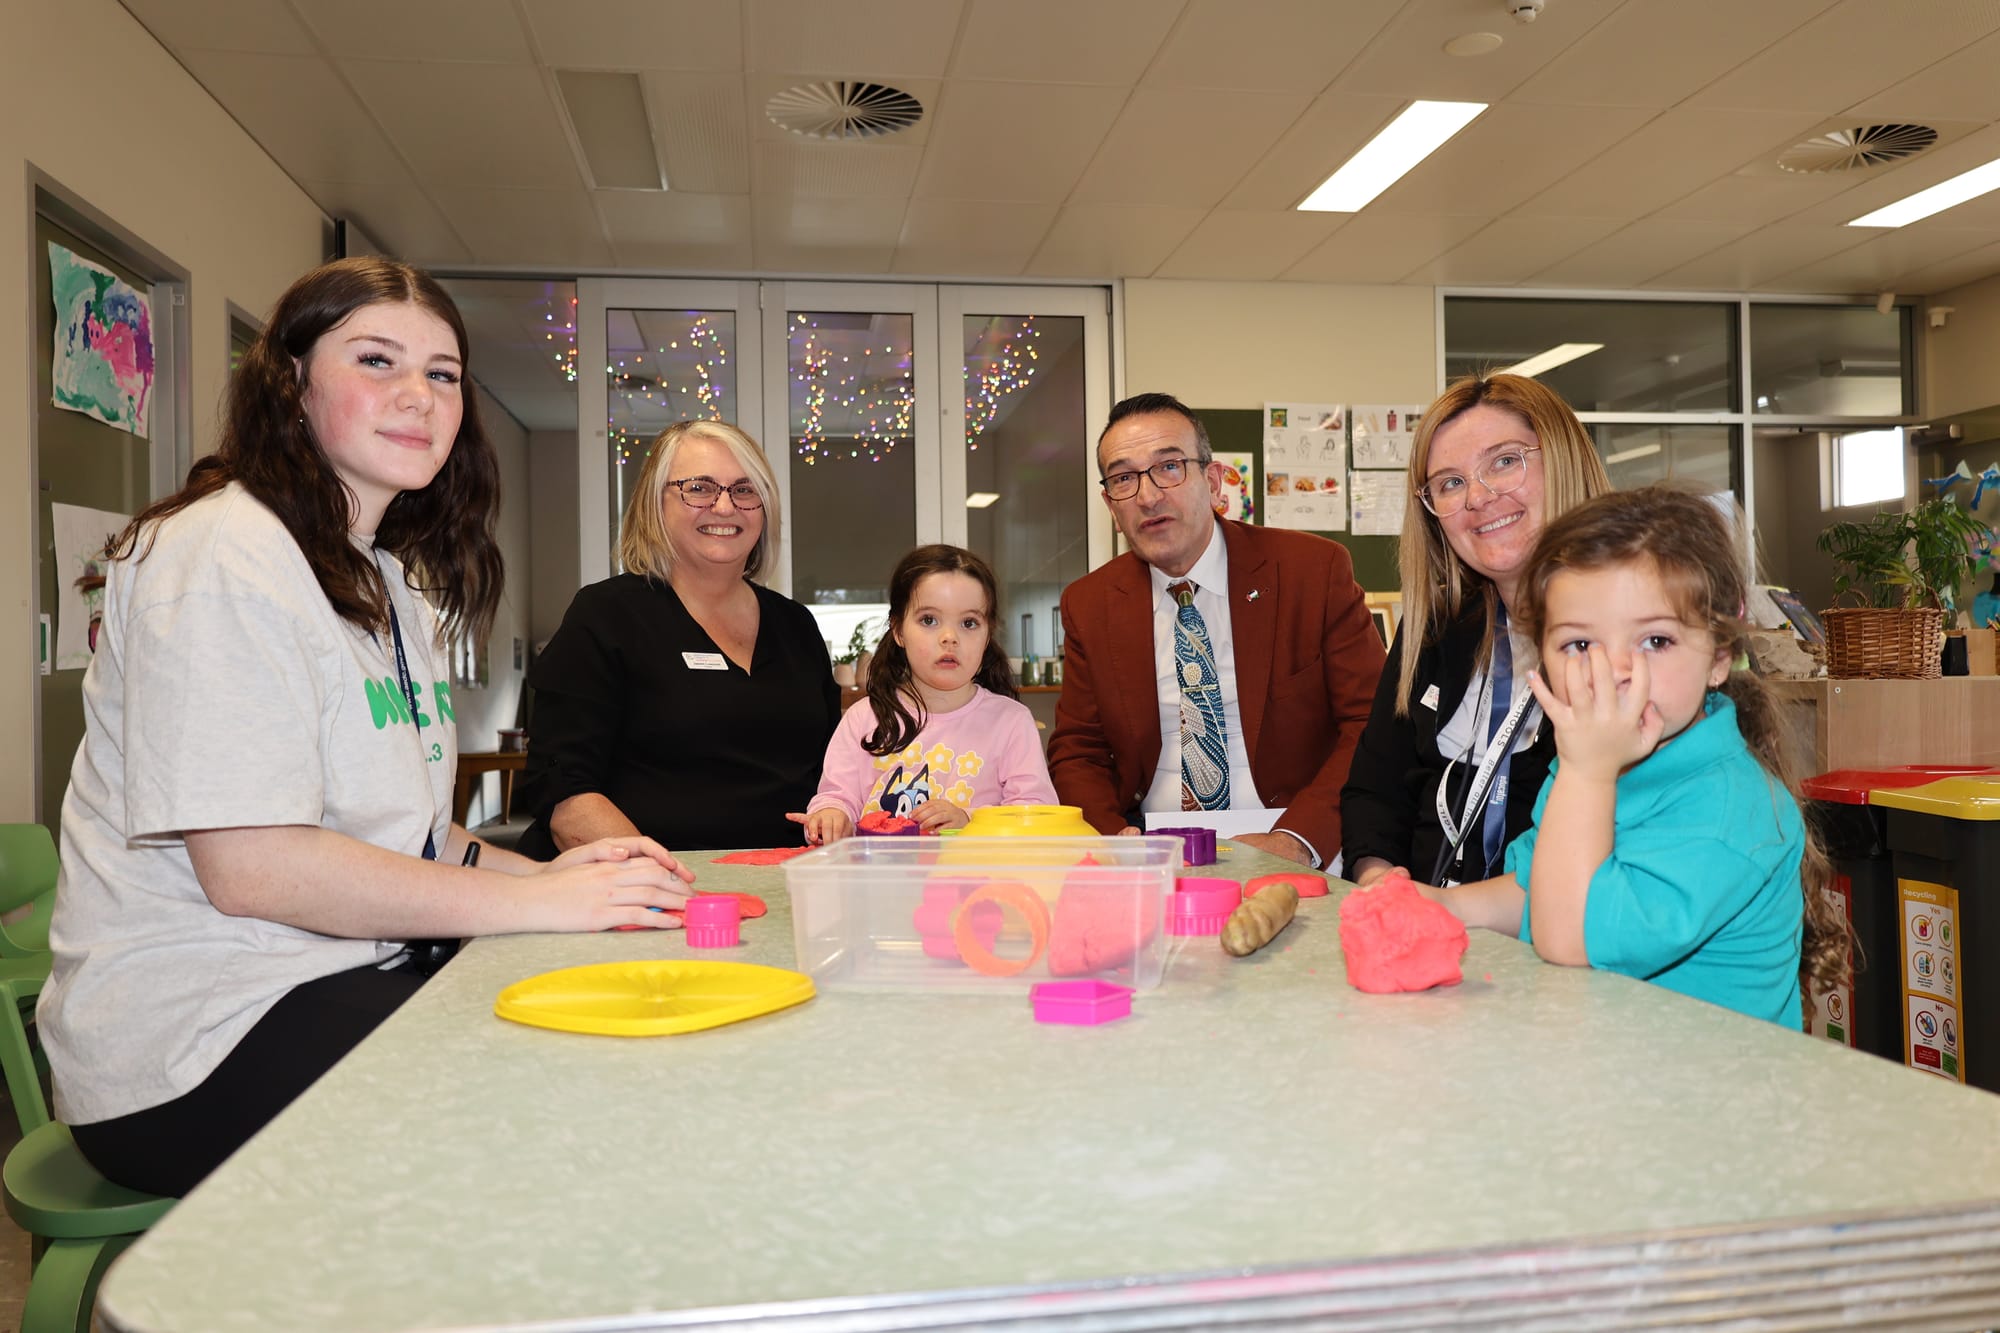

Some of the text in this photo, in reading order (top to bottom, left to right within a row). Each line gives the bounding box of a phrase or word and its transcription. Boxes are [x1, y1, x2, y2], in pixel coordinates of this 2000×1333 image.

[1497, 696, 1528, 748] SCHOOLS
[1478, 759, 1495, 790] Better
[1903, 888, 1937, 901] Recycling
[1930, 906, 1942, 915] Yes
[1935, 1003, 1944, 1013] No
